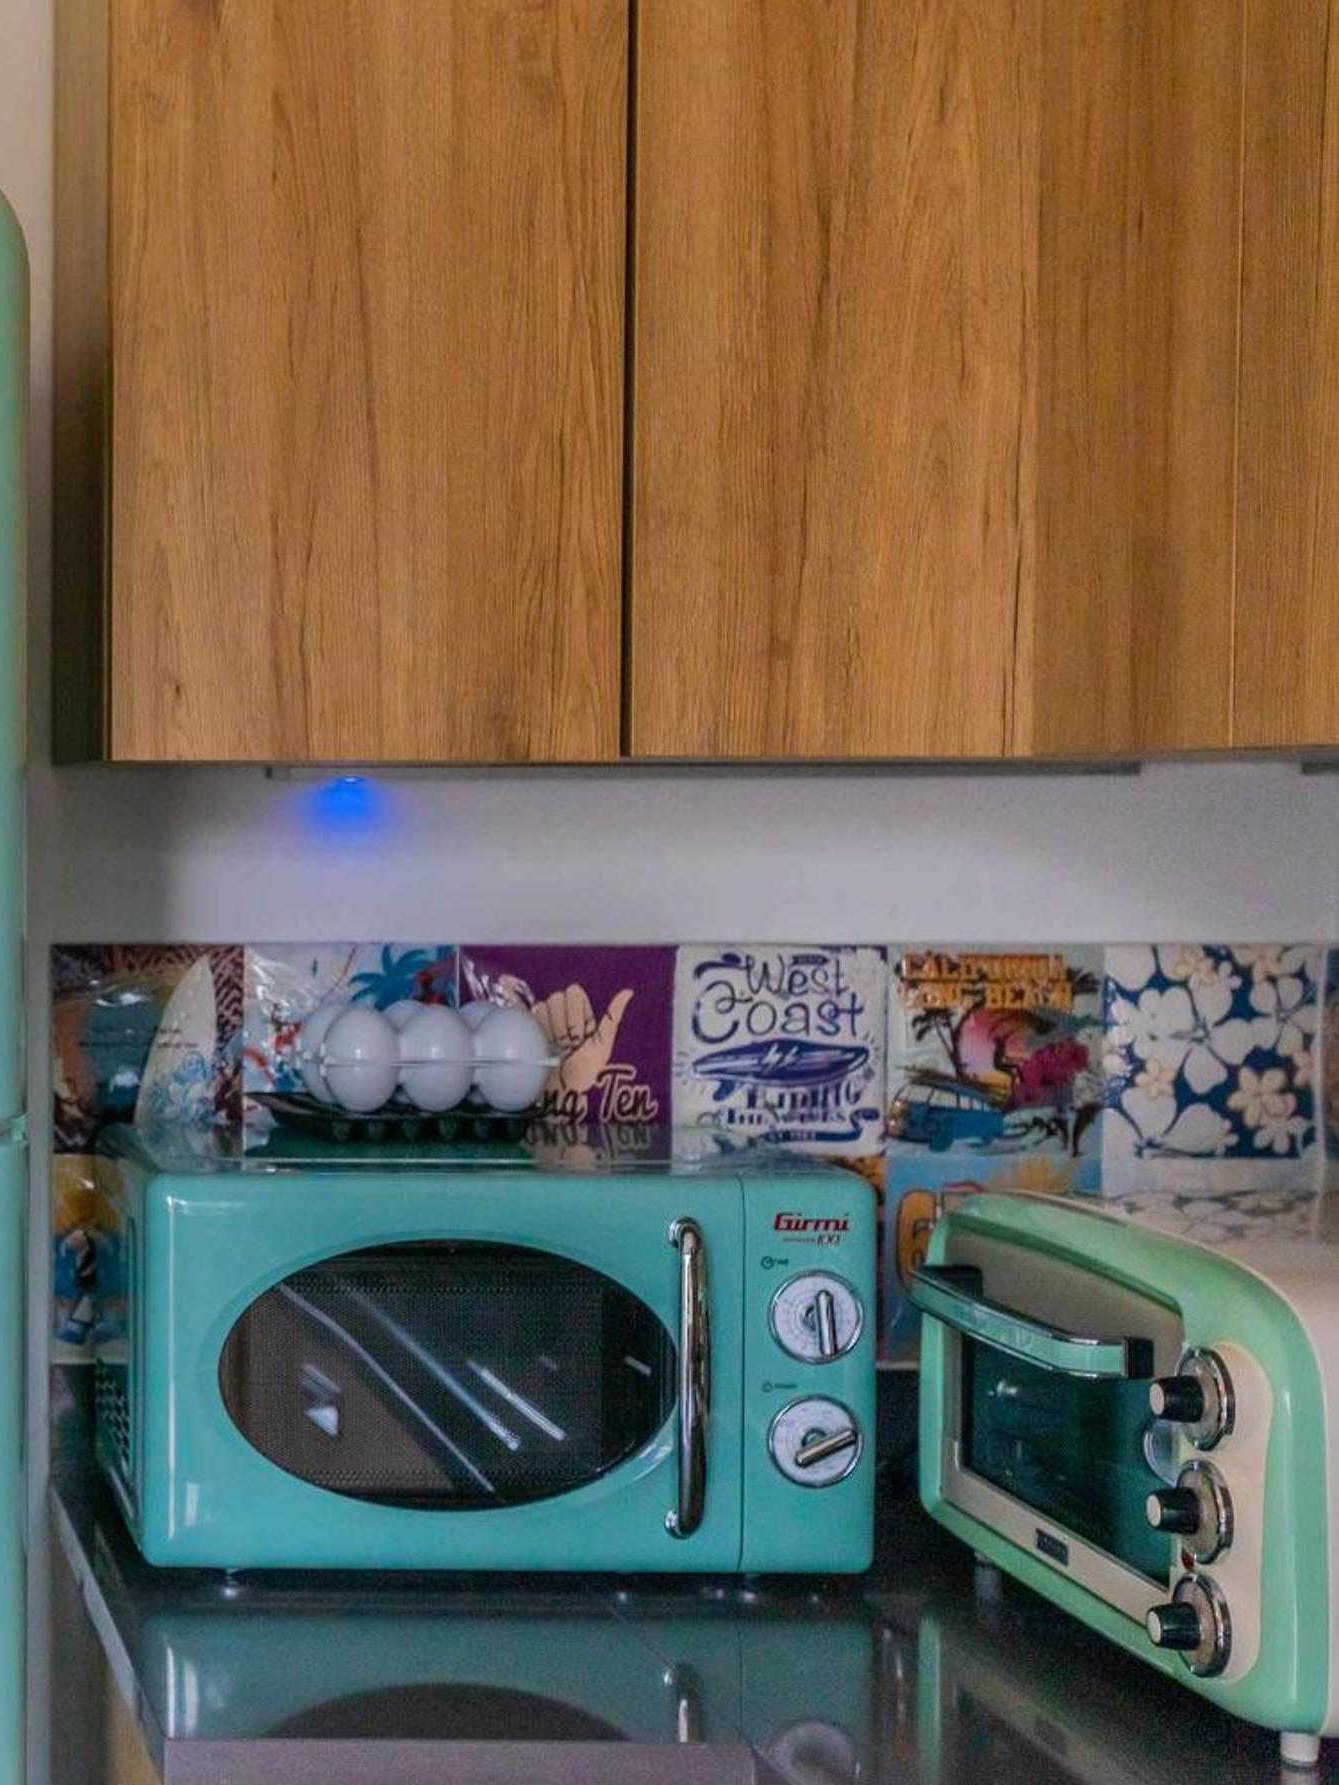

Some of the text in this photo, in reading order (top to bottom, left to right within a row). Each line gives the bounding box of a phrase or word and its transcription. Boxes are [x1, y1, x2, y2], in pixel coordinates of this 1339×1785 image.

[744, 953, 849, 998] West
[692, 980, 865, 1044] Coast
[597, 1064, 659, 1123] Ten
[773, 1212, 851, 1232] Girmi
